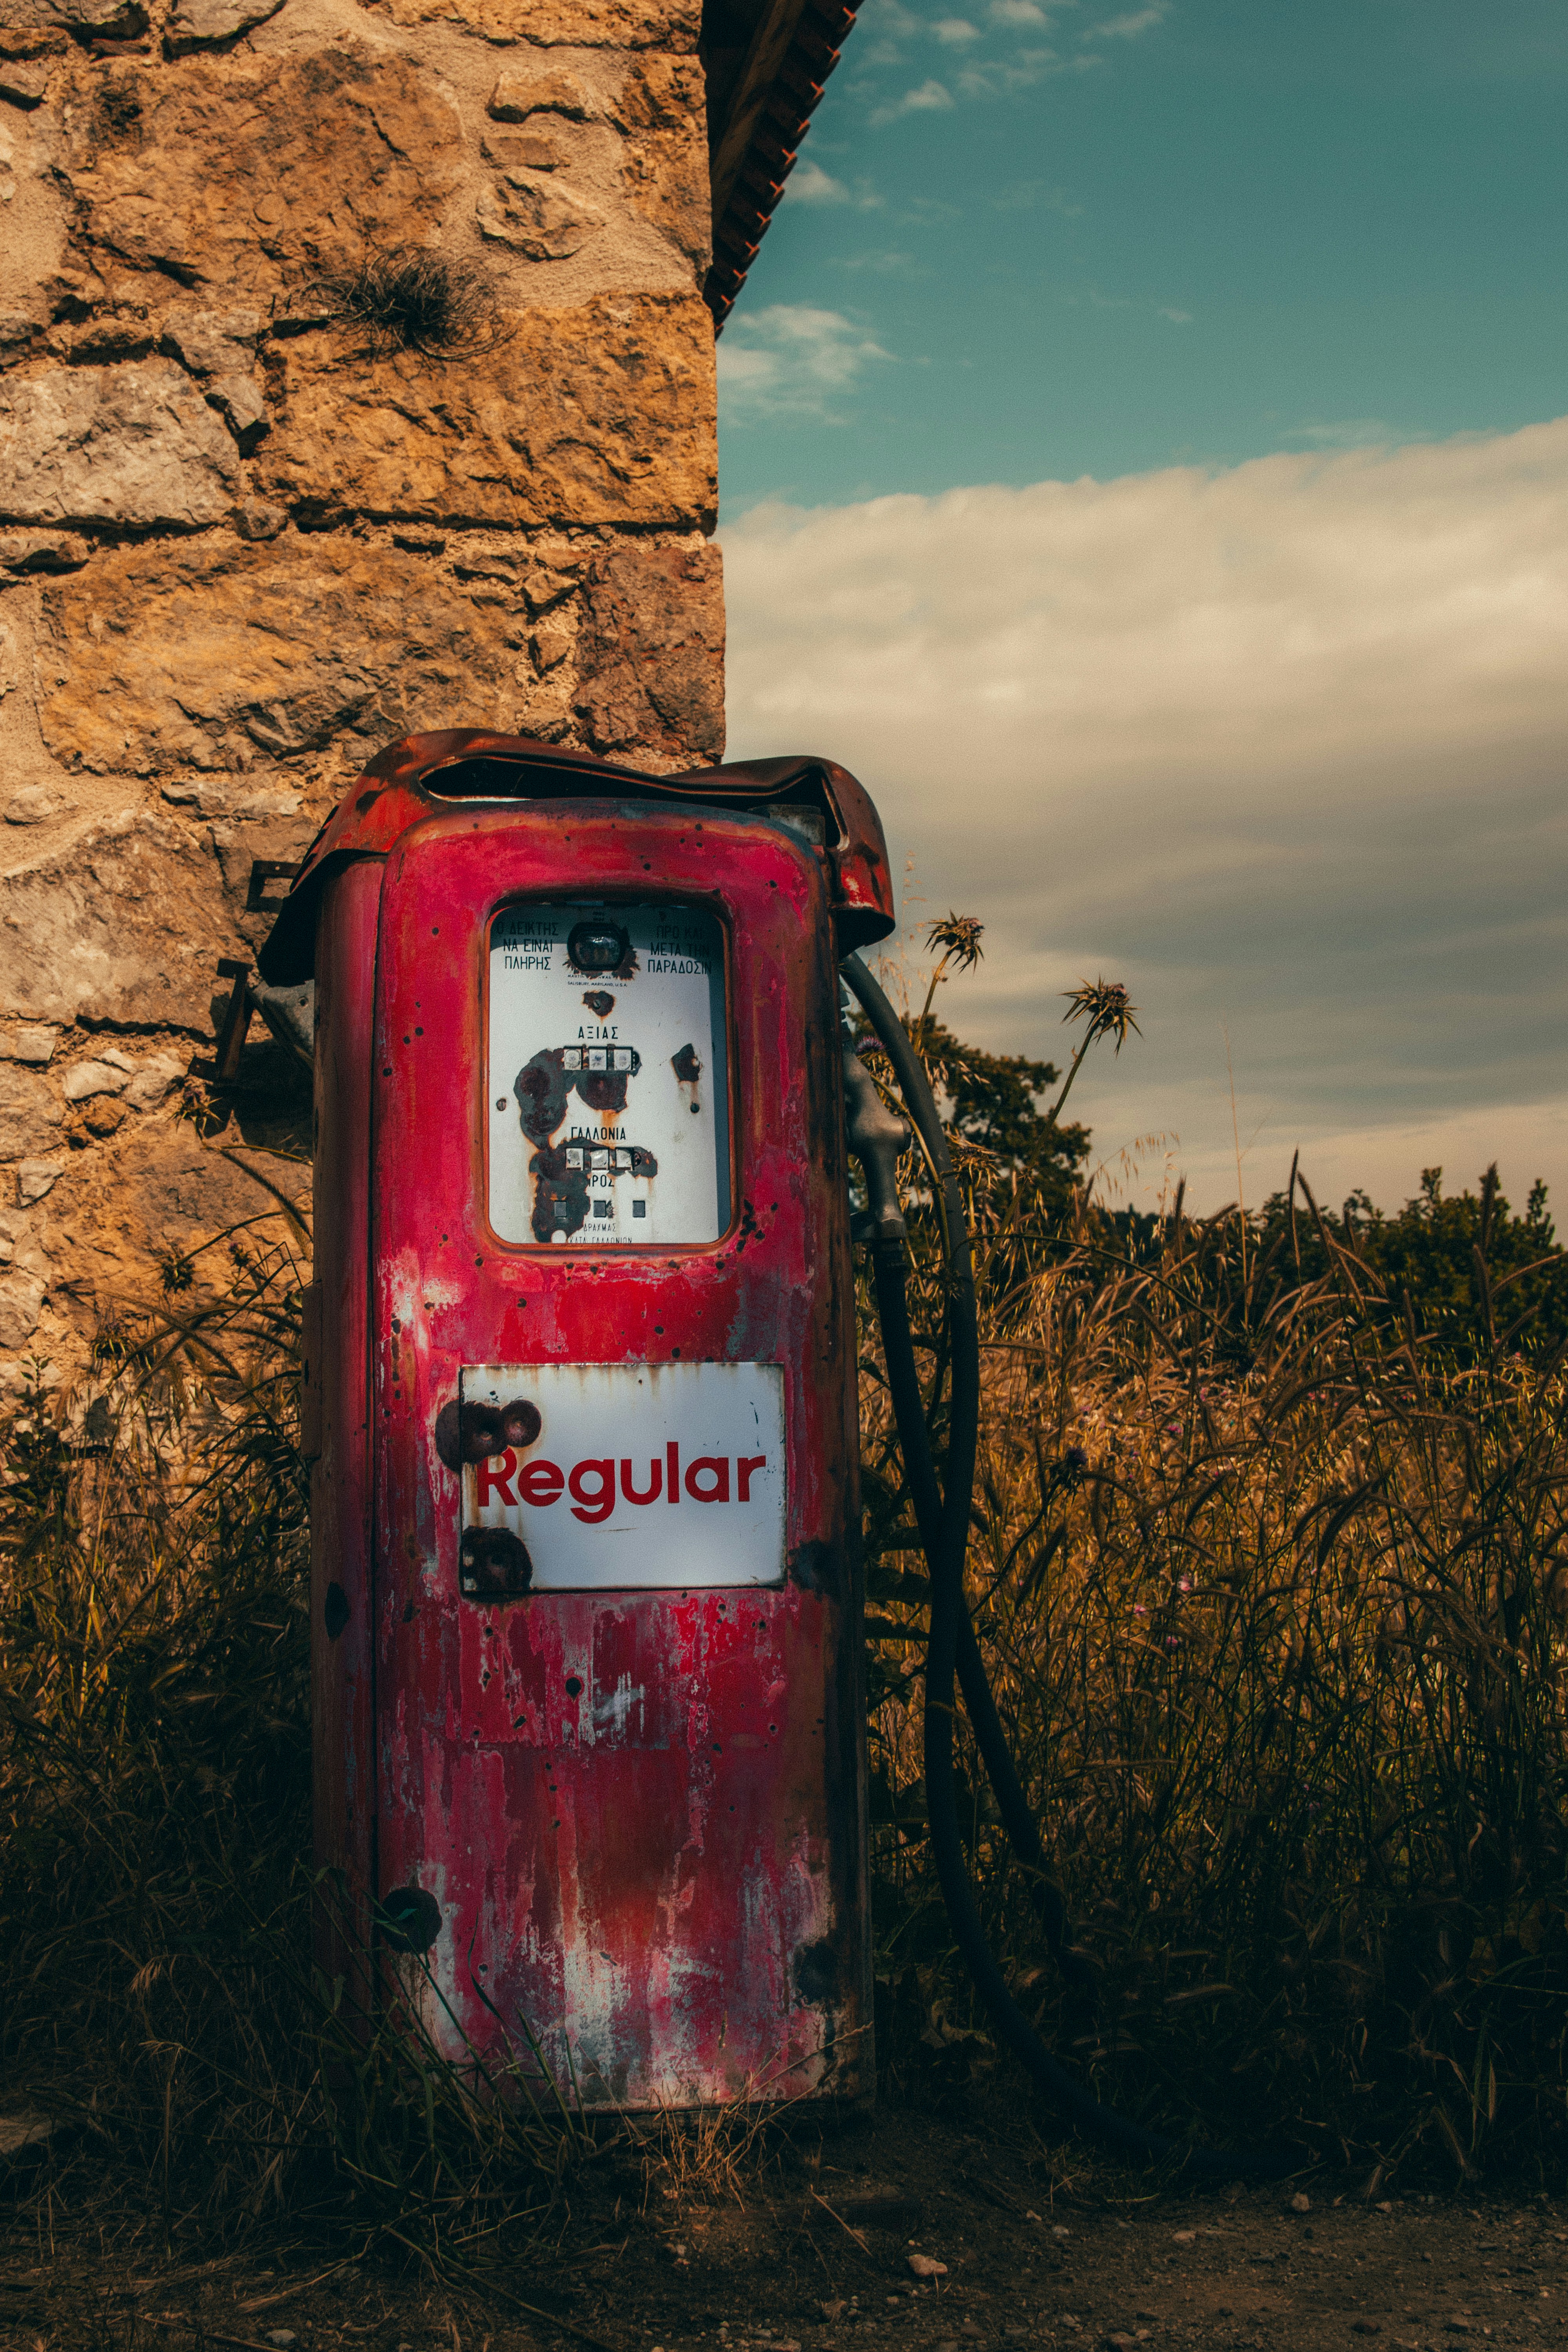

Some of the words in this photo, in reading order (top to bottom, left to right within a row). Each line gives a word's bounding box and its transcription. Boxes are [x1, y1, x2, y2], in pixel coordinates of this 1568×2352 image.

[510, 922, 559, 936] ΔΕΙΚΤΗΣ
[656, 926, 679, 939] ΠΡΟ
[503, 938, 518, 952] ΝΑ
[524, 938, 553, 953] ΕΙΝΑΙ
[650, 942, 681, 956] ΜΕΤΑ
[505, 956, 551, 970] ΠΛΗΡΗΣ
[648, 960, 712, 975] ΠΑΡΑΔΟΣΙΝ
[578, 1026, 618, 1039] ΑΞΙΑΣ
[571, 1127, 626, 1140] ΓΑΛΛΟΝΙΑ
[584, 1223, 616, 1232] ΔΡΑΧΜΑΣ
[477, 1441, 766, 1524] Regular
